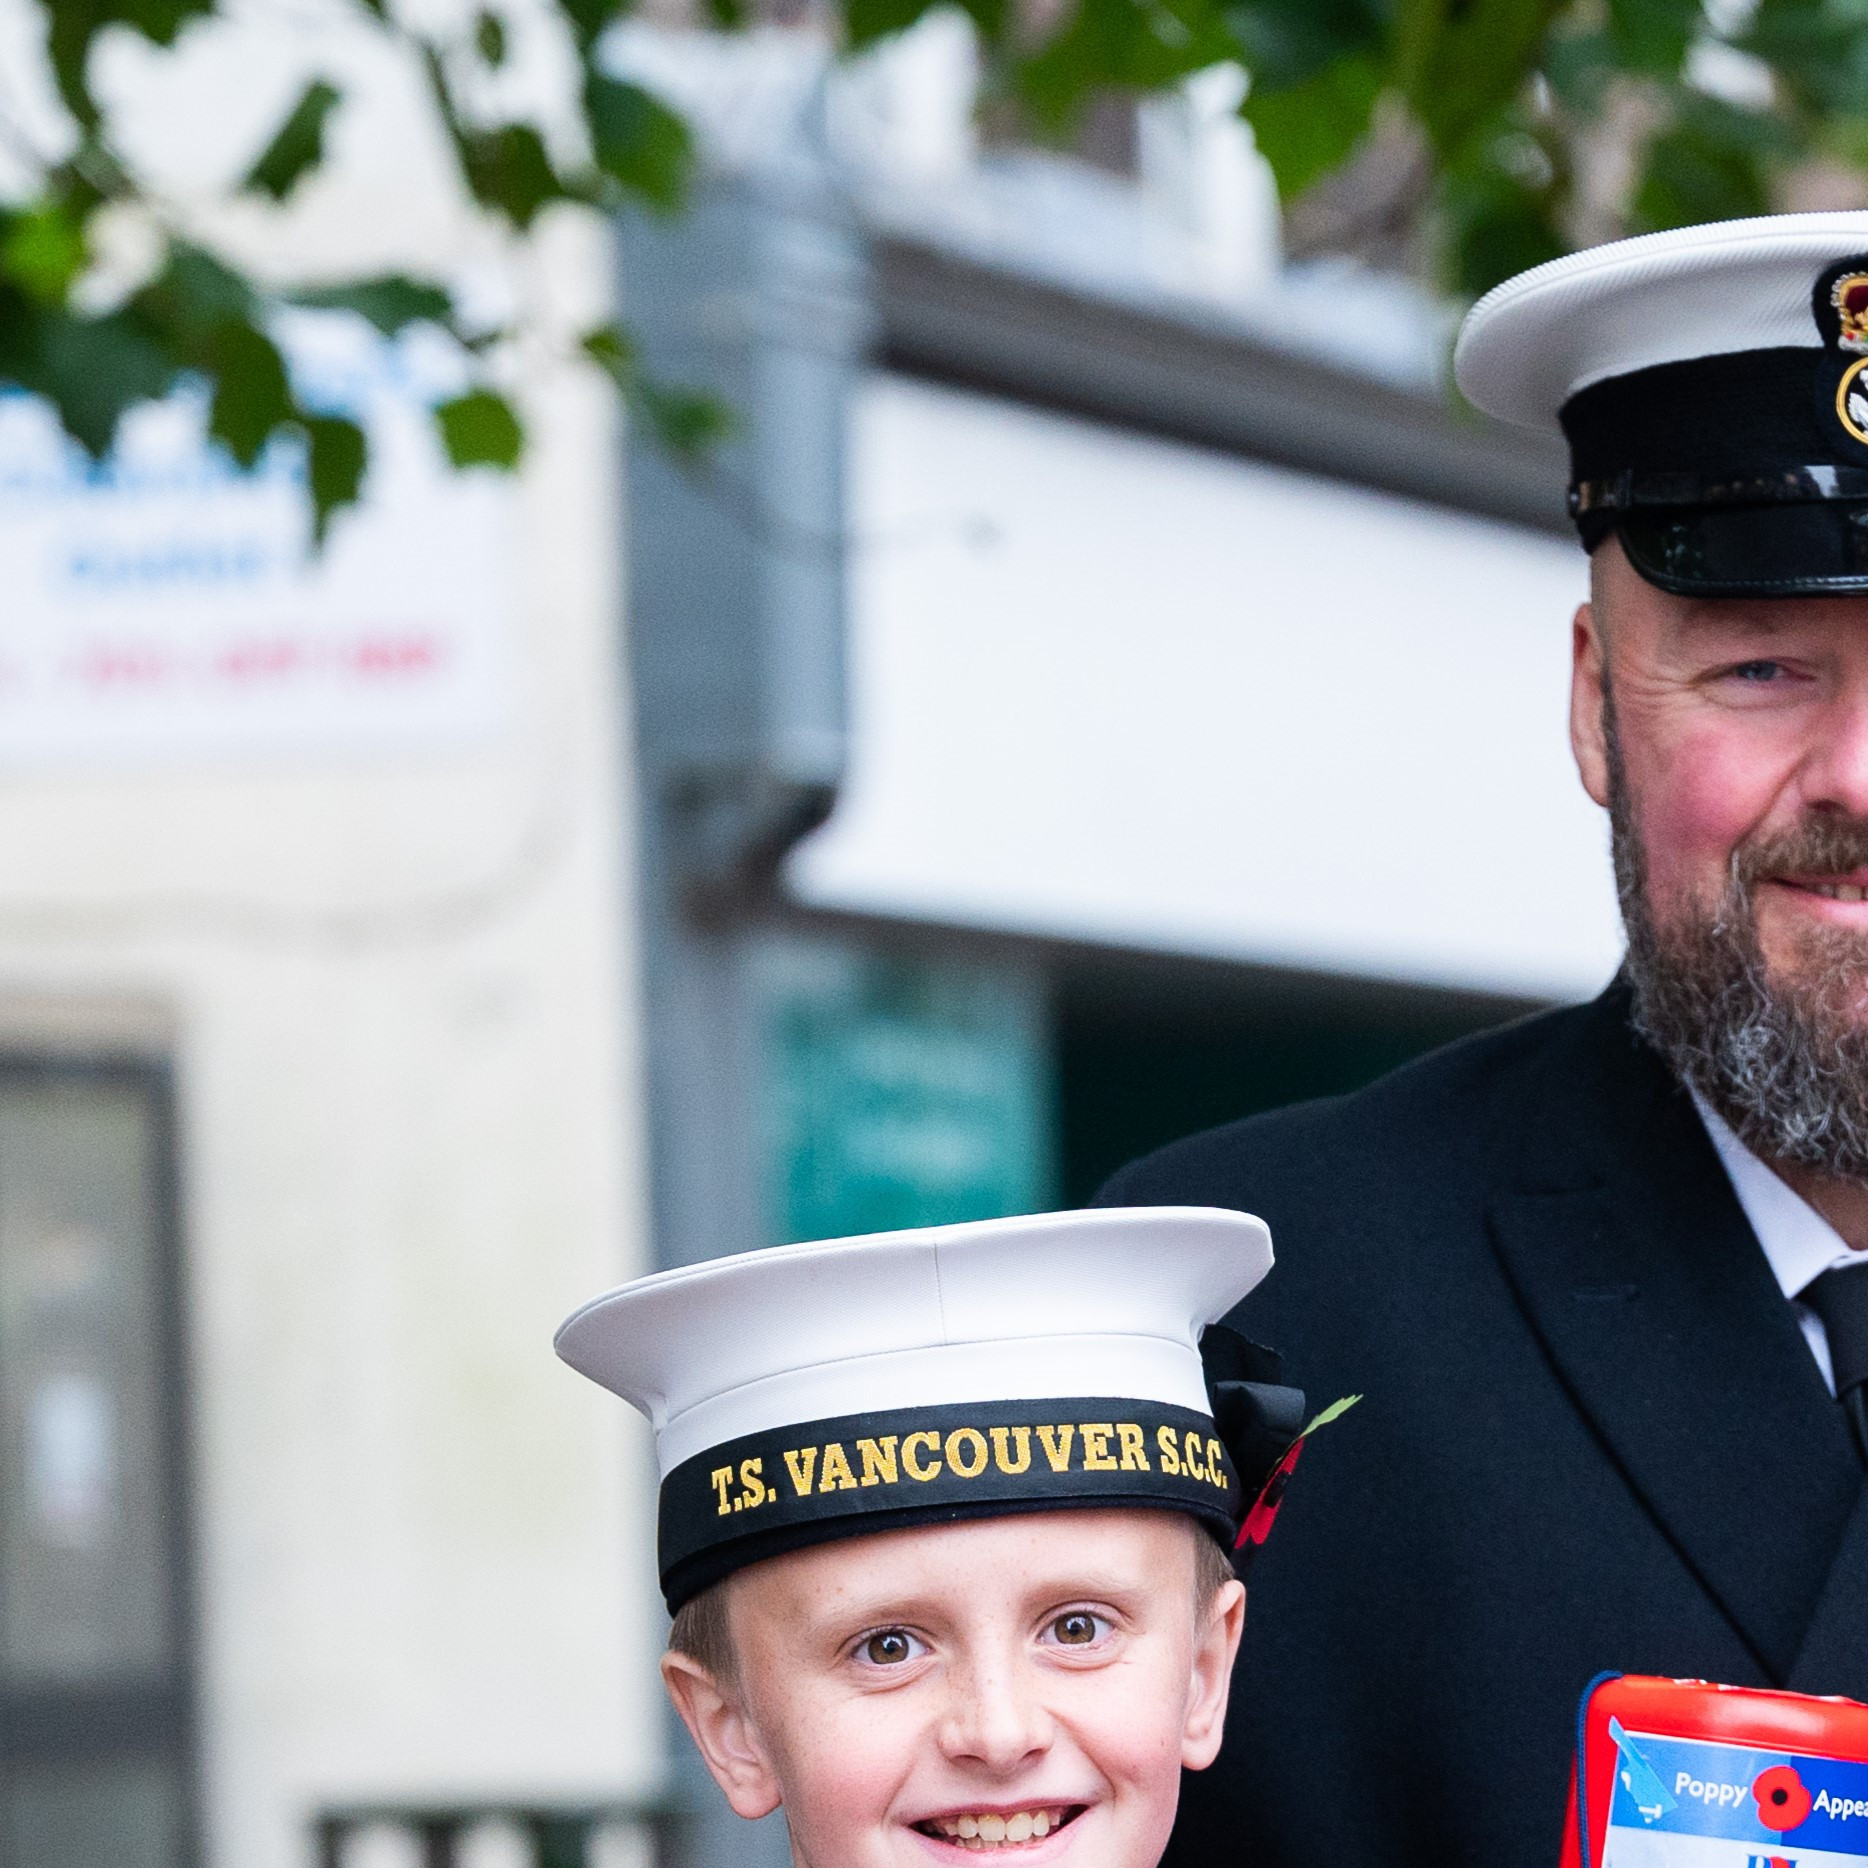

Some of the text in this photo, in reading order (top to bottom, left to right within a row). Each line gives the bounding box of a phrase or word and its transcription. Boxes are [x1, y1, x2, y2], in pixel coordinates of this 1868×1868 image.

[711, 1422, 1229, 1516] T.S. VANCOUVER S.C.C.
[1674, 1771, 1749, 1809] Poppy
